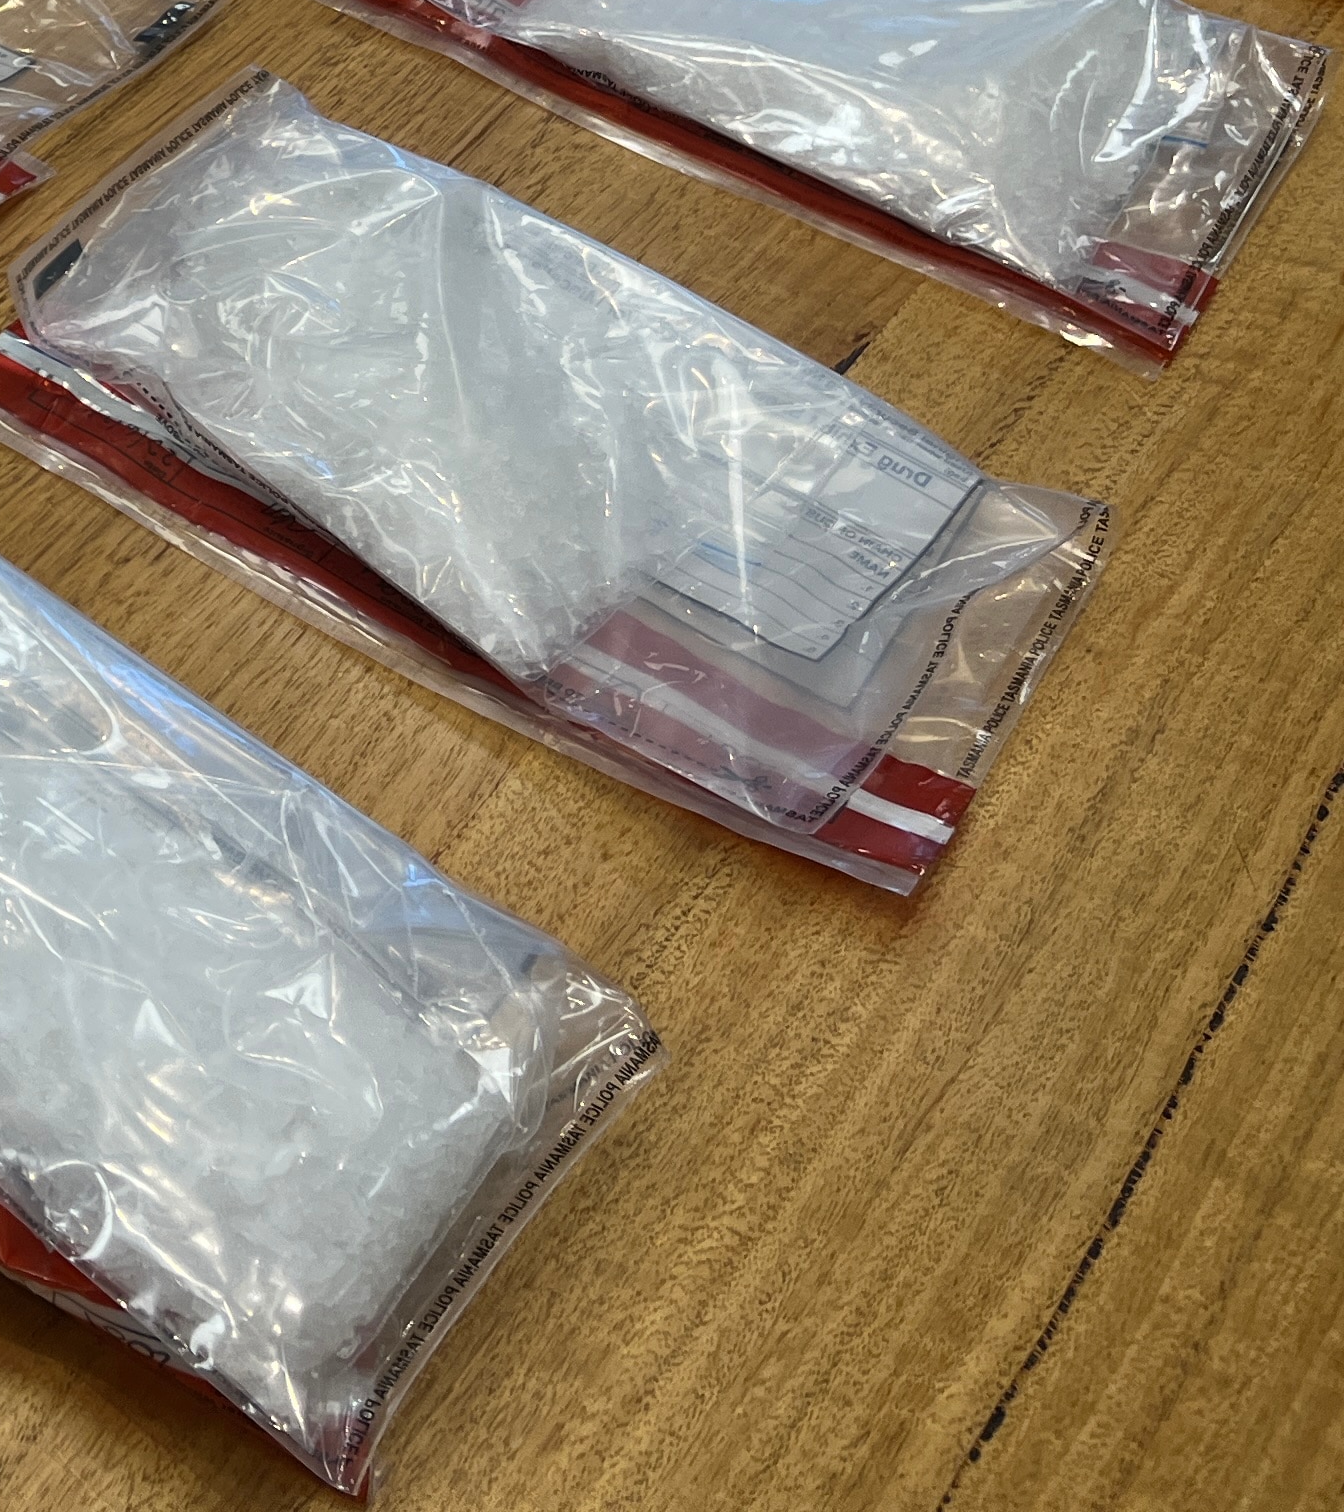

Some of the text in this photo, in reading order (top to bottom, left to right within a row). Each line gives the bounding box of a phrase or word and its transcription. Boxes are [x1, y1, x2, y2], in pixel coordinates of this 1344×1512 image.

[956, 618, 1059, 780] TASMANIA POLICE TASMANIA POLICE
